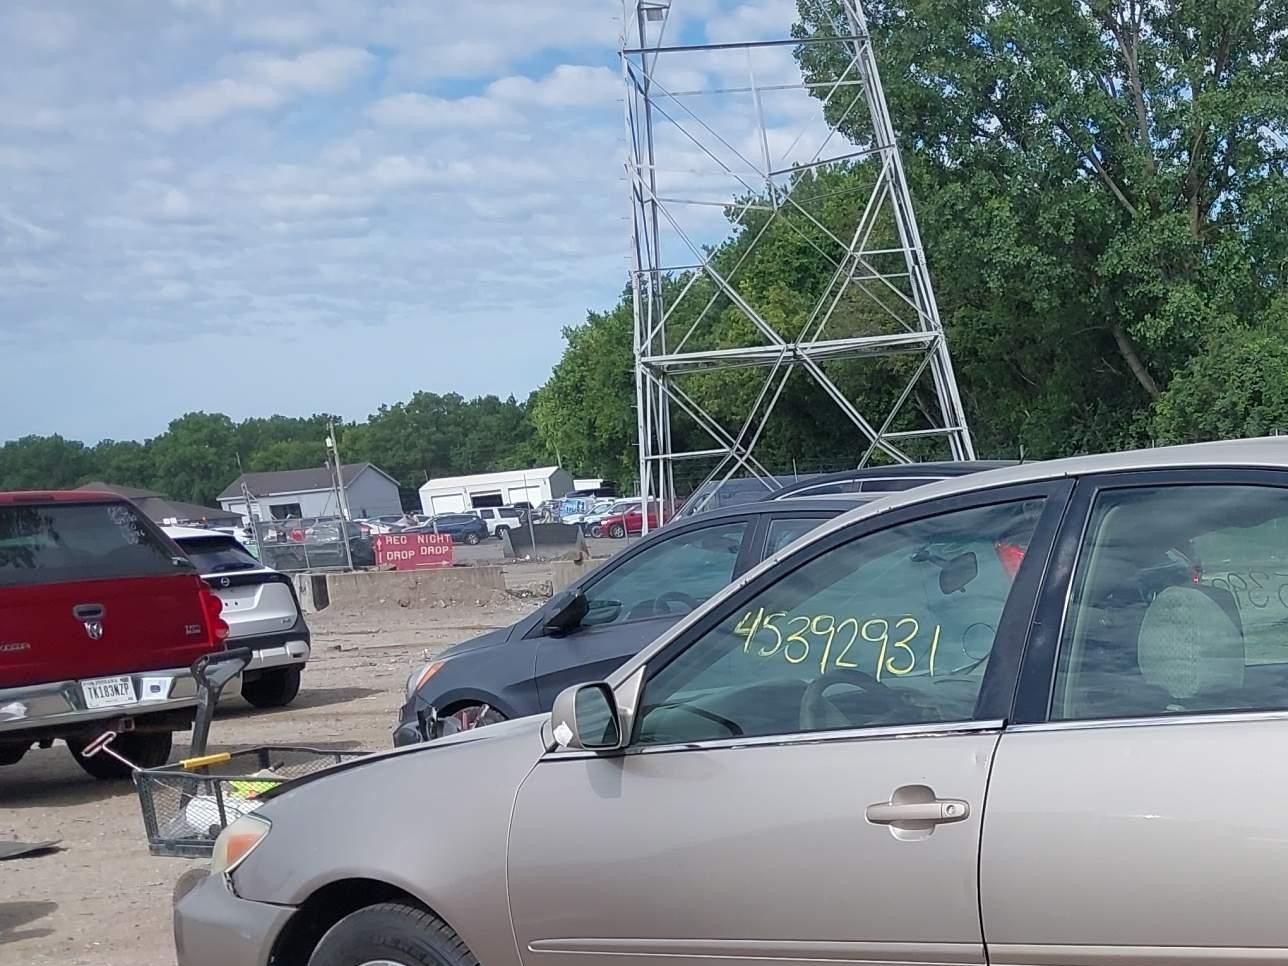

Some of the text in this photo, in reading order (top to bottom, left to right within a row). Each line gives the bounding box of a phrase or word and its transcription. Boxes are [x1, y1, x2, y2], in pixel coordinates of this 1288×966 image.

[417, 534, 451, 544] NIGHT
[386, 550, 416, 560] DROP
[420, 546, 449, 555] DROP
[734, 607, 941, 682] 45392931
[88, 683, 130, 700] TK183NZP
